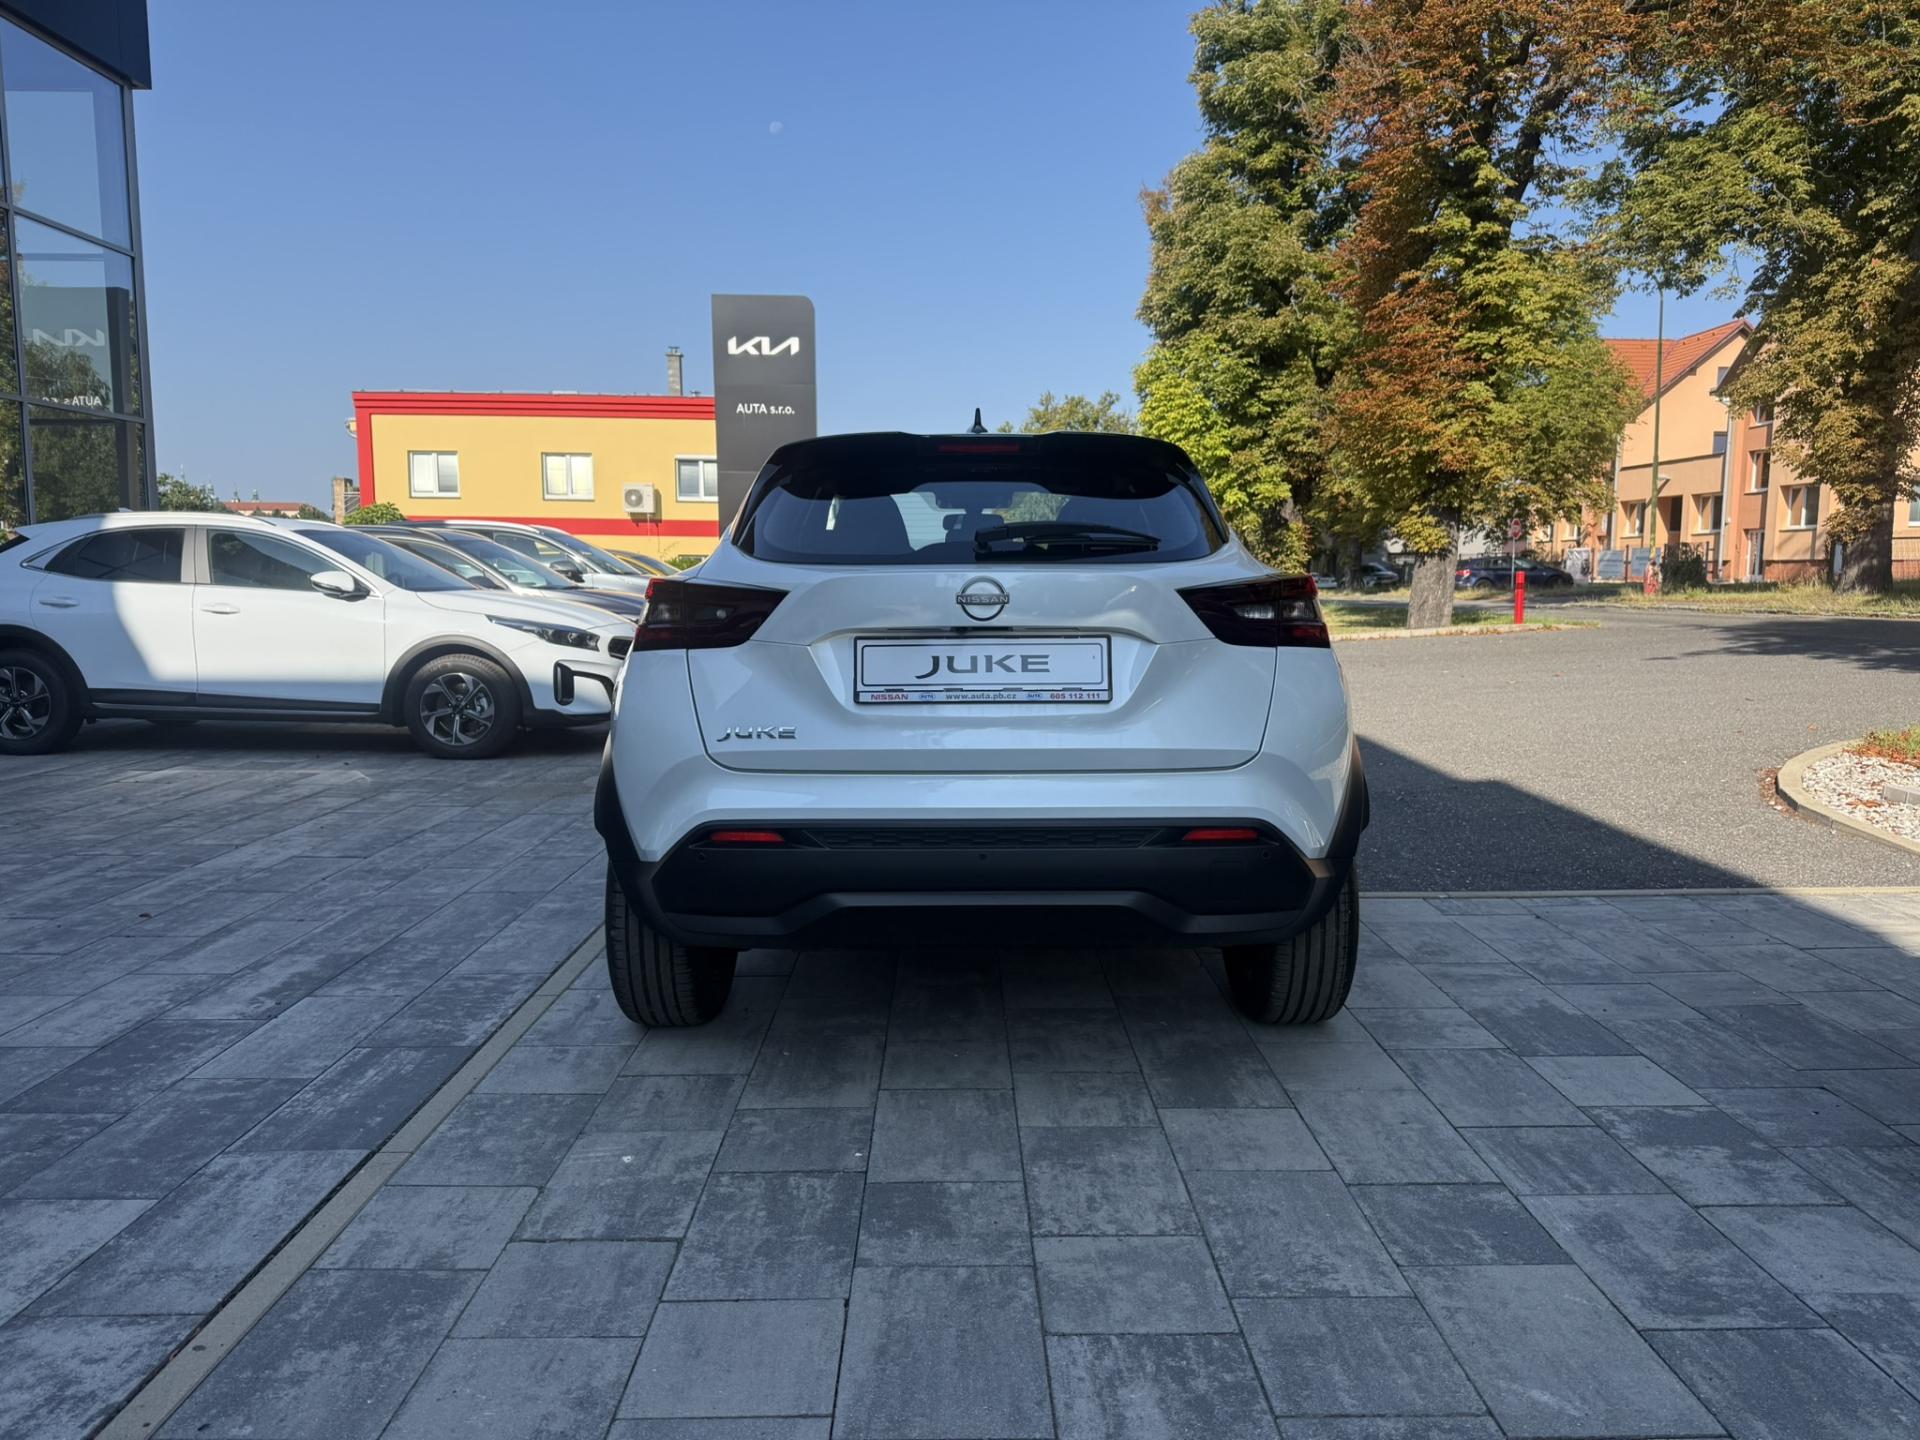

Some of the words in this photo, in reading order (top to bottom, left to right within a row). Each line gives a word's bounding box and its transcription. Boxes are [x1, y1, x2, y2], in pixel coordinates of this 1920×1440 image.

[728, 336, 799, 356] KIA
[736, 403, 767, 414] AUTA
[770, 405, 795, 414] s.r.o.
[914, 654, 1050, 679] JUKE
[870, 693, 909, 701] NISSAN
[945, 692, 1017, 700] www.auta.pb.cz
[716, 726, 796, 742] JUKE
